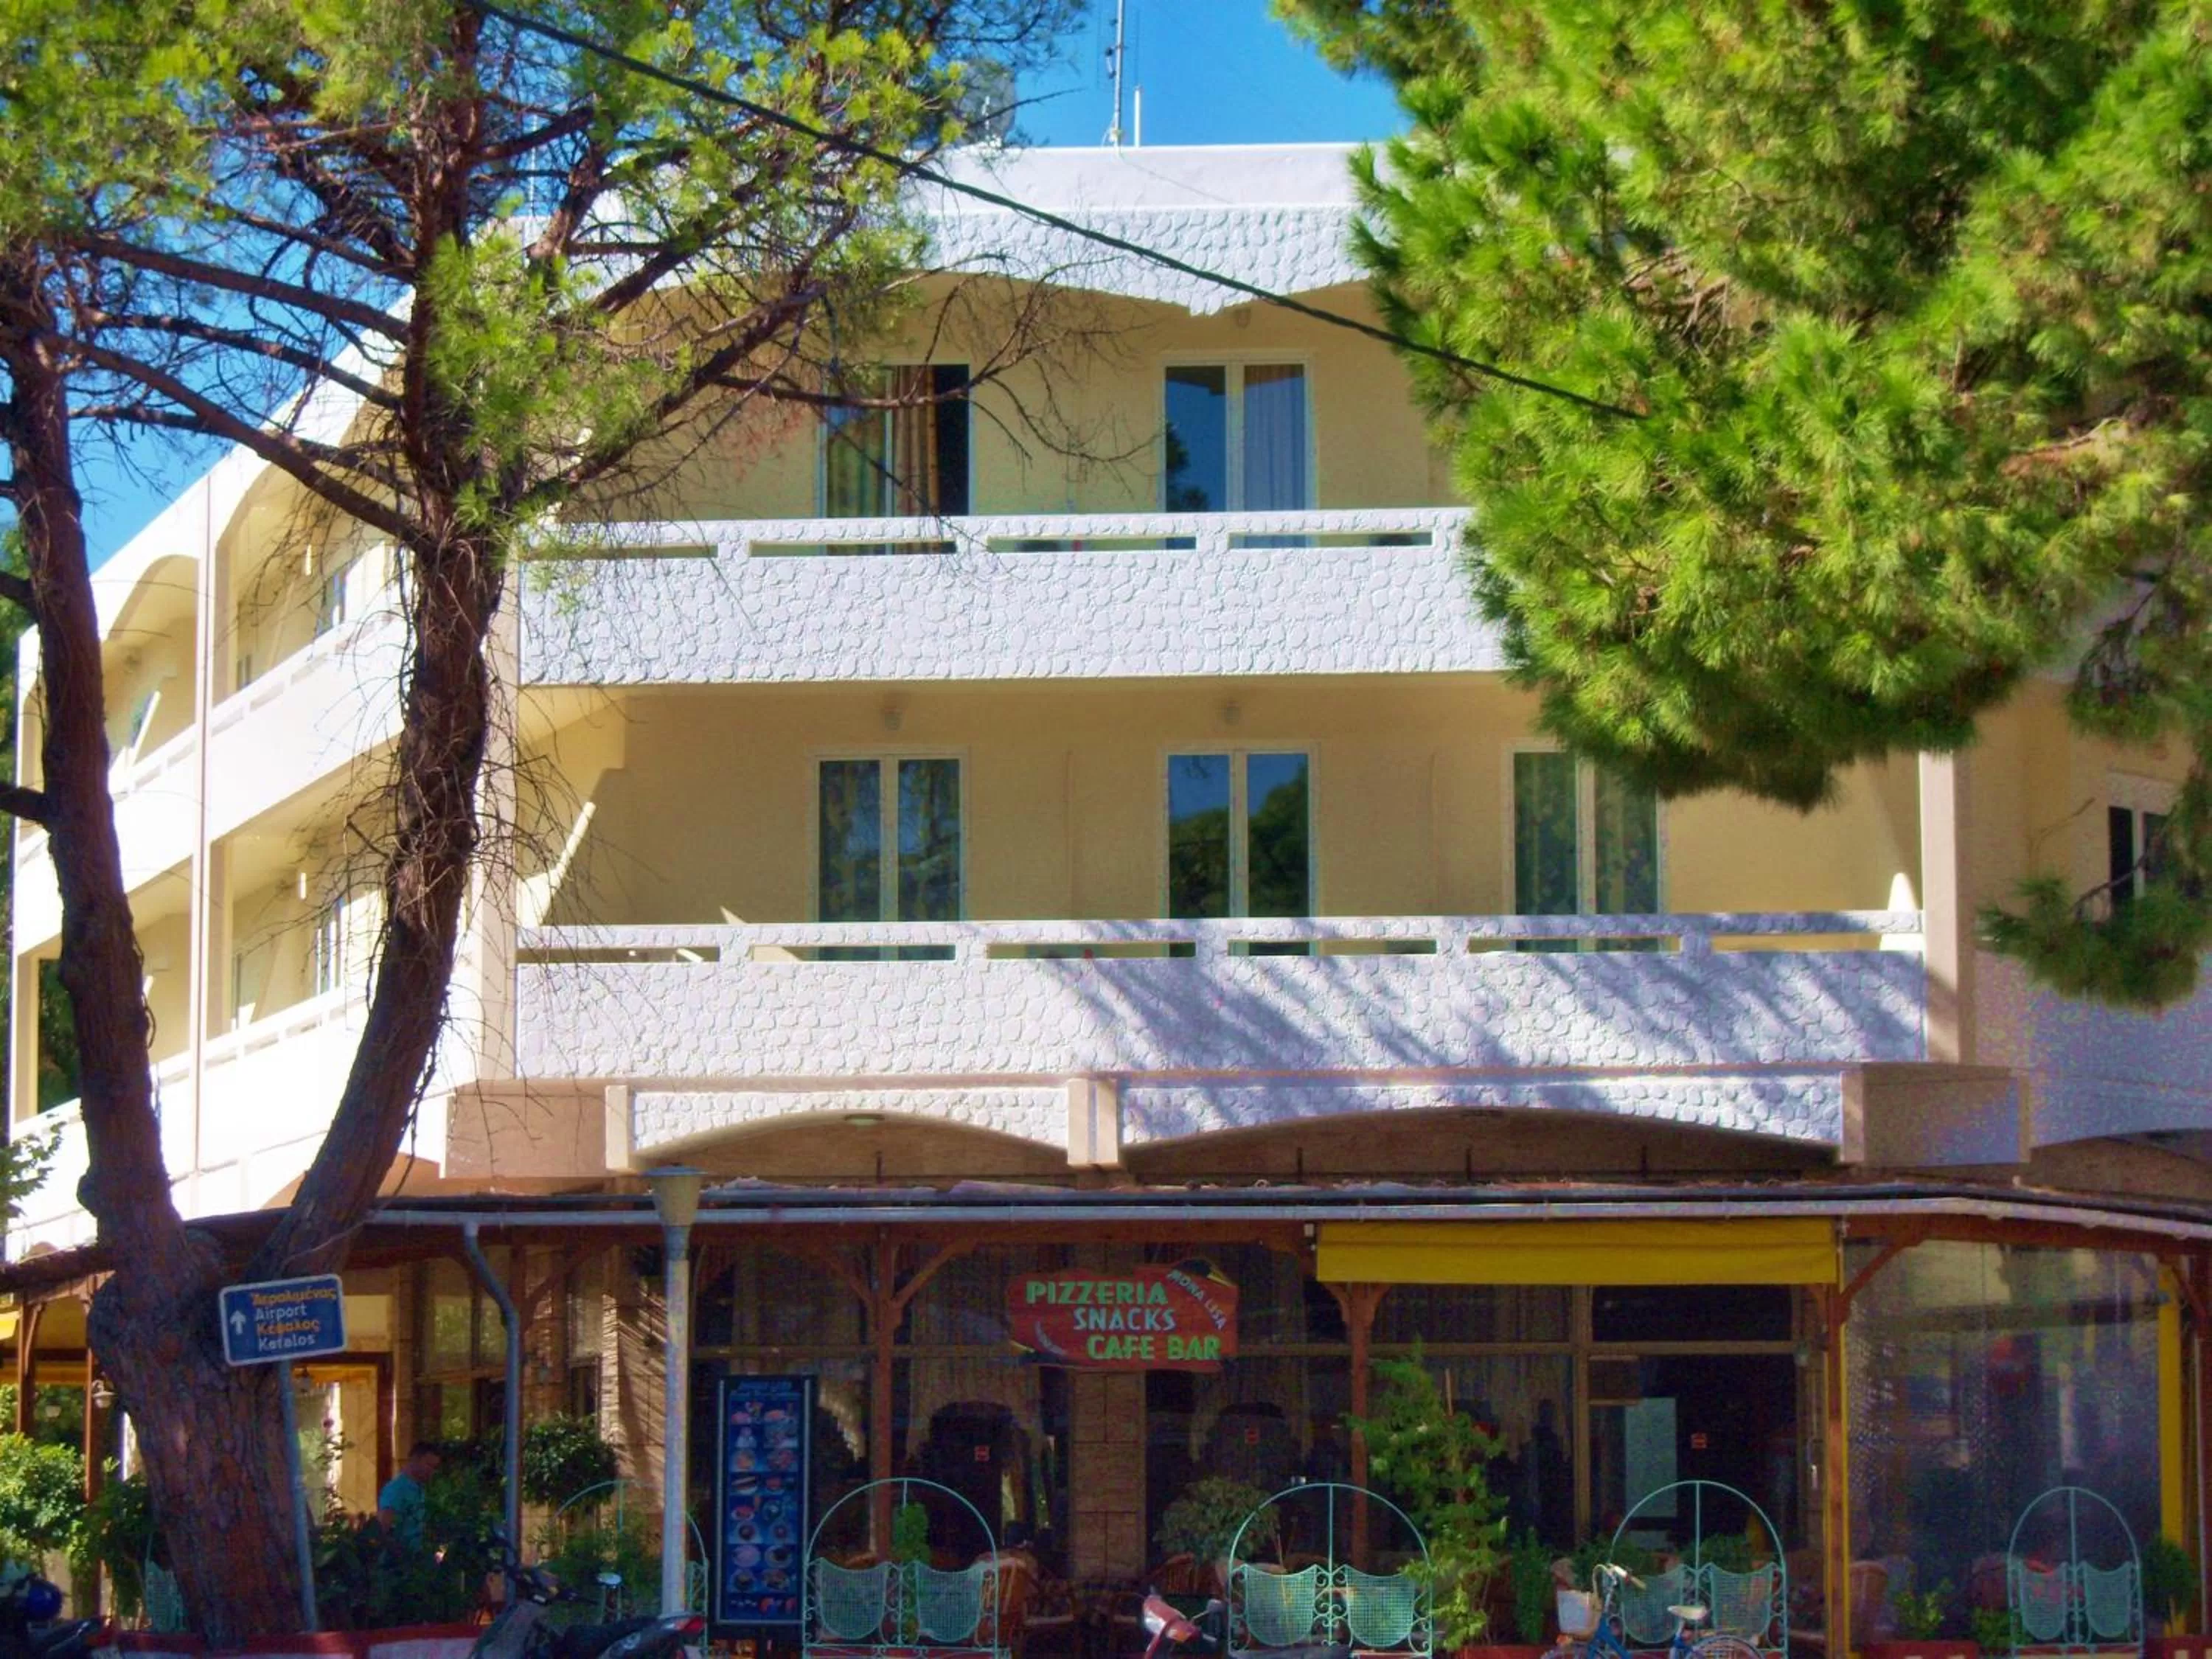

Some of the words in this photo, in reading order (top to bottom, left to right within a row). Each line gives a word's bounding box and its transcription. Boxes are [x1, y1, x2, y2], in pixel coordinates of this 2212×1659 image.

[1026, 1281, 1169, 1306] PIZZERIA
[255, 1303, 307, 1321] Airport
[1074, 1307, 1177, 1331] SNACKS
[259, 1334, 316, 1352] Kefalos
[1087, 1335, 1155, 1360] CAFE
[1167, 1335, 1222, 1361] BAR
